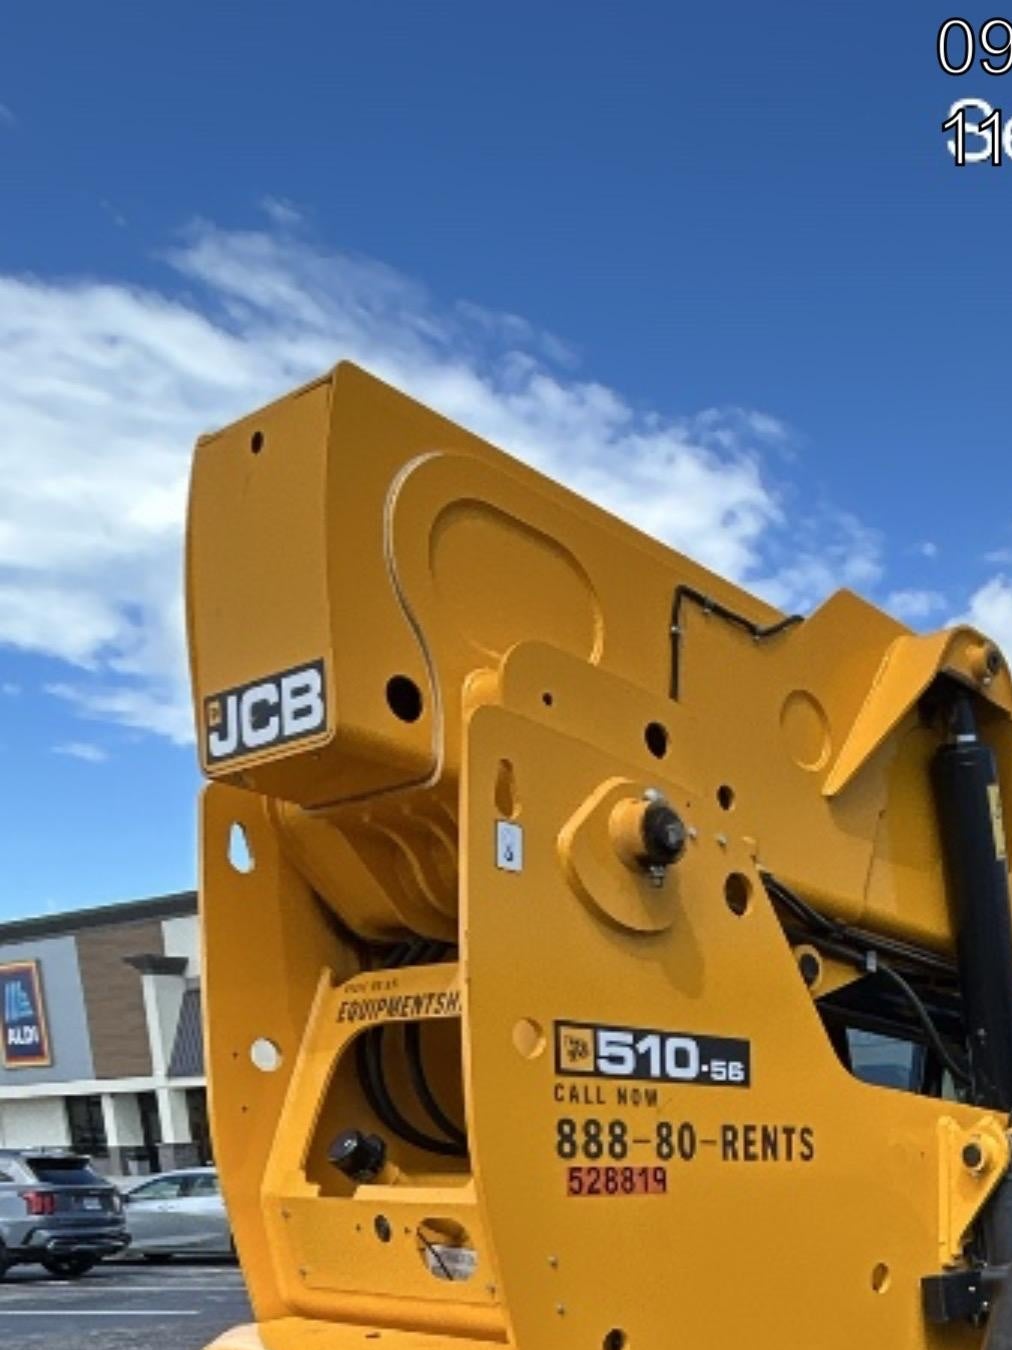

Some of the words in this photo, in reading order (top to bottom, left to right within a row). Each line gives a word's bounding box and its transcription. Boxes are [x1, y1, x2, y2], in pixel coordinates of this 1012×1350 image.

[207, 667, 325, 759] JCB
[336, 989, 463, 1023] EQUIPMENTSH
[554, 1083, 606, 1105] CALL
[617, 1086, 659, 1108] NOW
[556, 1117, 815, 1162] 888-80-RENTS
